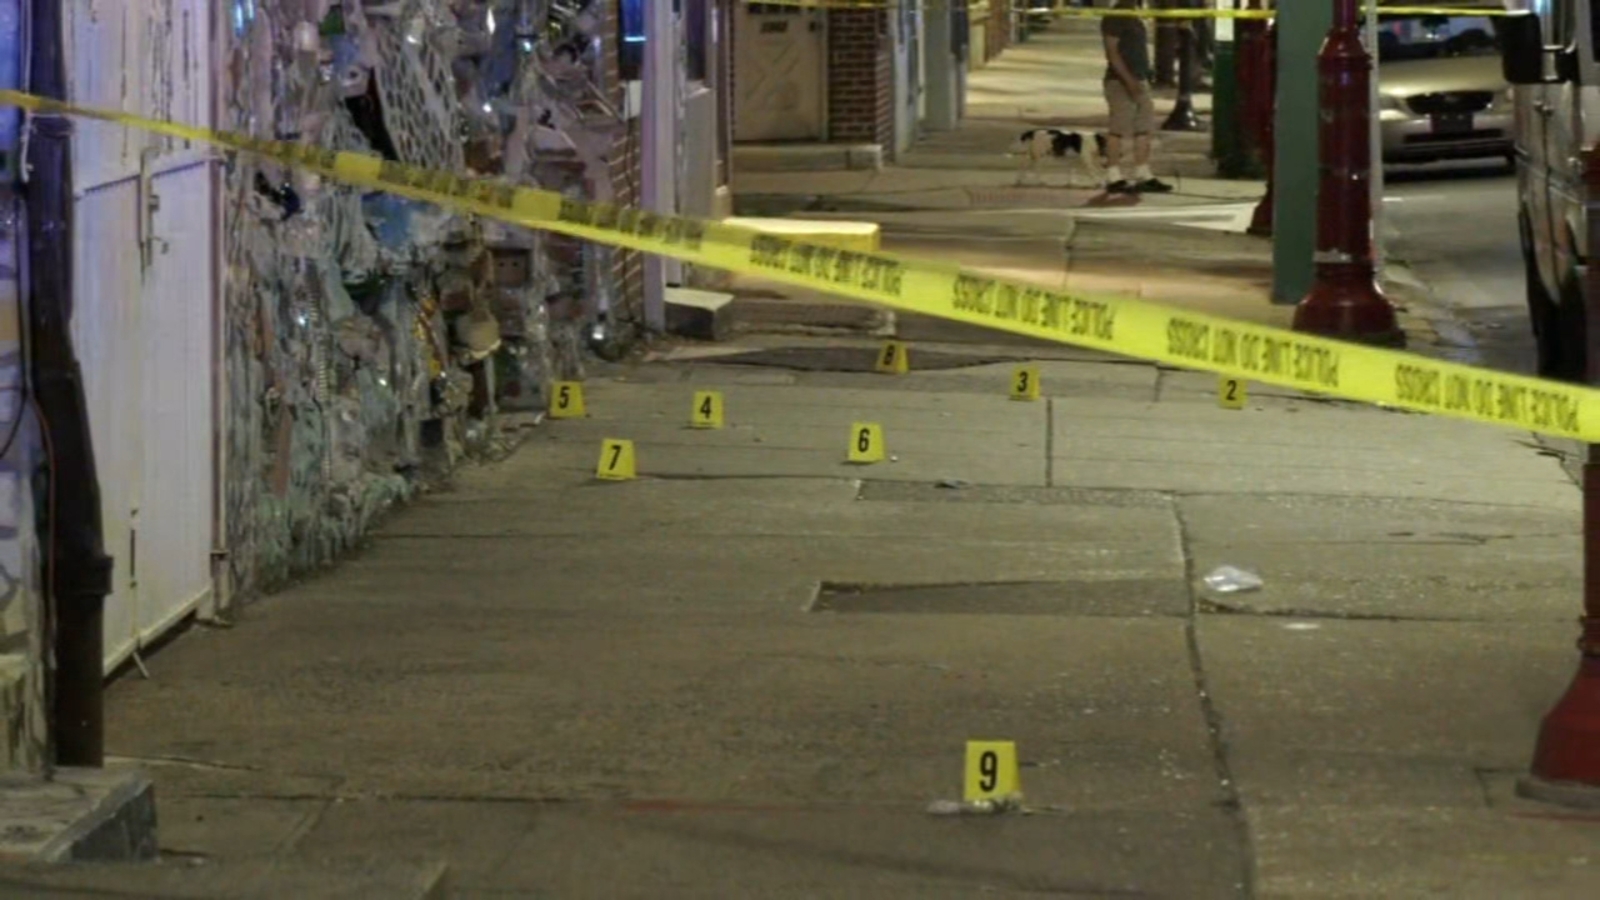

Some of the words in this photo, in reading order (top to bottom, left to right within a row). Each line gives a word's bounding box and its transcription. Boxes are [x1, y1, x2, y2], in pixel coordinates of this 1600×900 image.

[952, 273, 995, 314] CROSS
[995, 283, 1017, 319] NOT
[1021, 288, 1041, 323] DO
[1041, 292, 1070, 329] LINE
[1071, 298, 1116, 340] POLICE
[1167, 316, 1210, 360] CROSS
[1211, 327, 1237, 366] NOT
[1240, 333, 1260, 369] DO
[1262, 337, 1291, 375] LINE
[1016, 371, 1029, 393] 3
[1294, 343, 1340, 387] POLICE
[558, 386, 570, 409] 5
[1226, 379, 1237, 400] 2
[1395, 363, 1441, 405] CROSS
[1444, 373, 1470, 411] NOT
[1474, 379, 1493, 416] DO
[1497, 383, 1528, 422] LINE
[700, 396, 712, 418] 4
[1531, 389, 1581, 432] POLICE
[607, 445, 622, 470] 7
[857, 428, 870, 452] 6
[979, 751, 998, 792] 9
